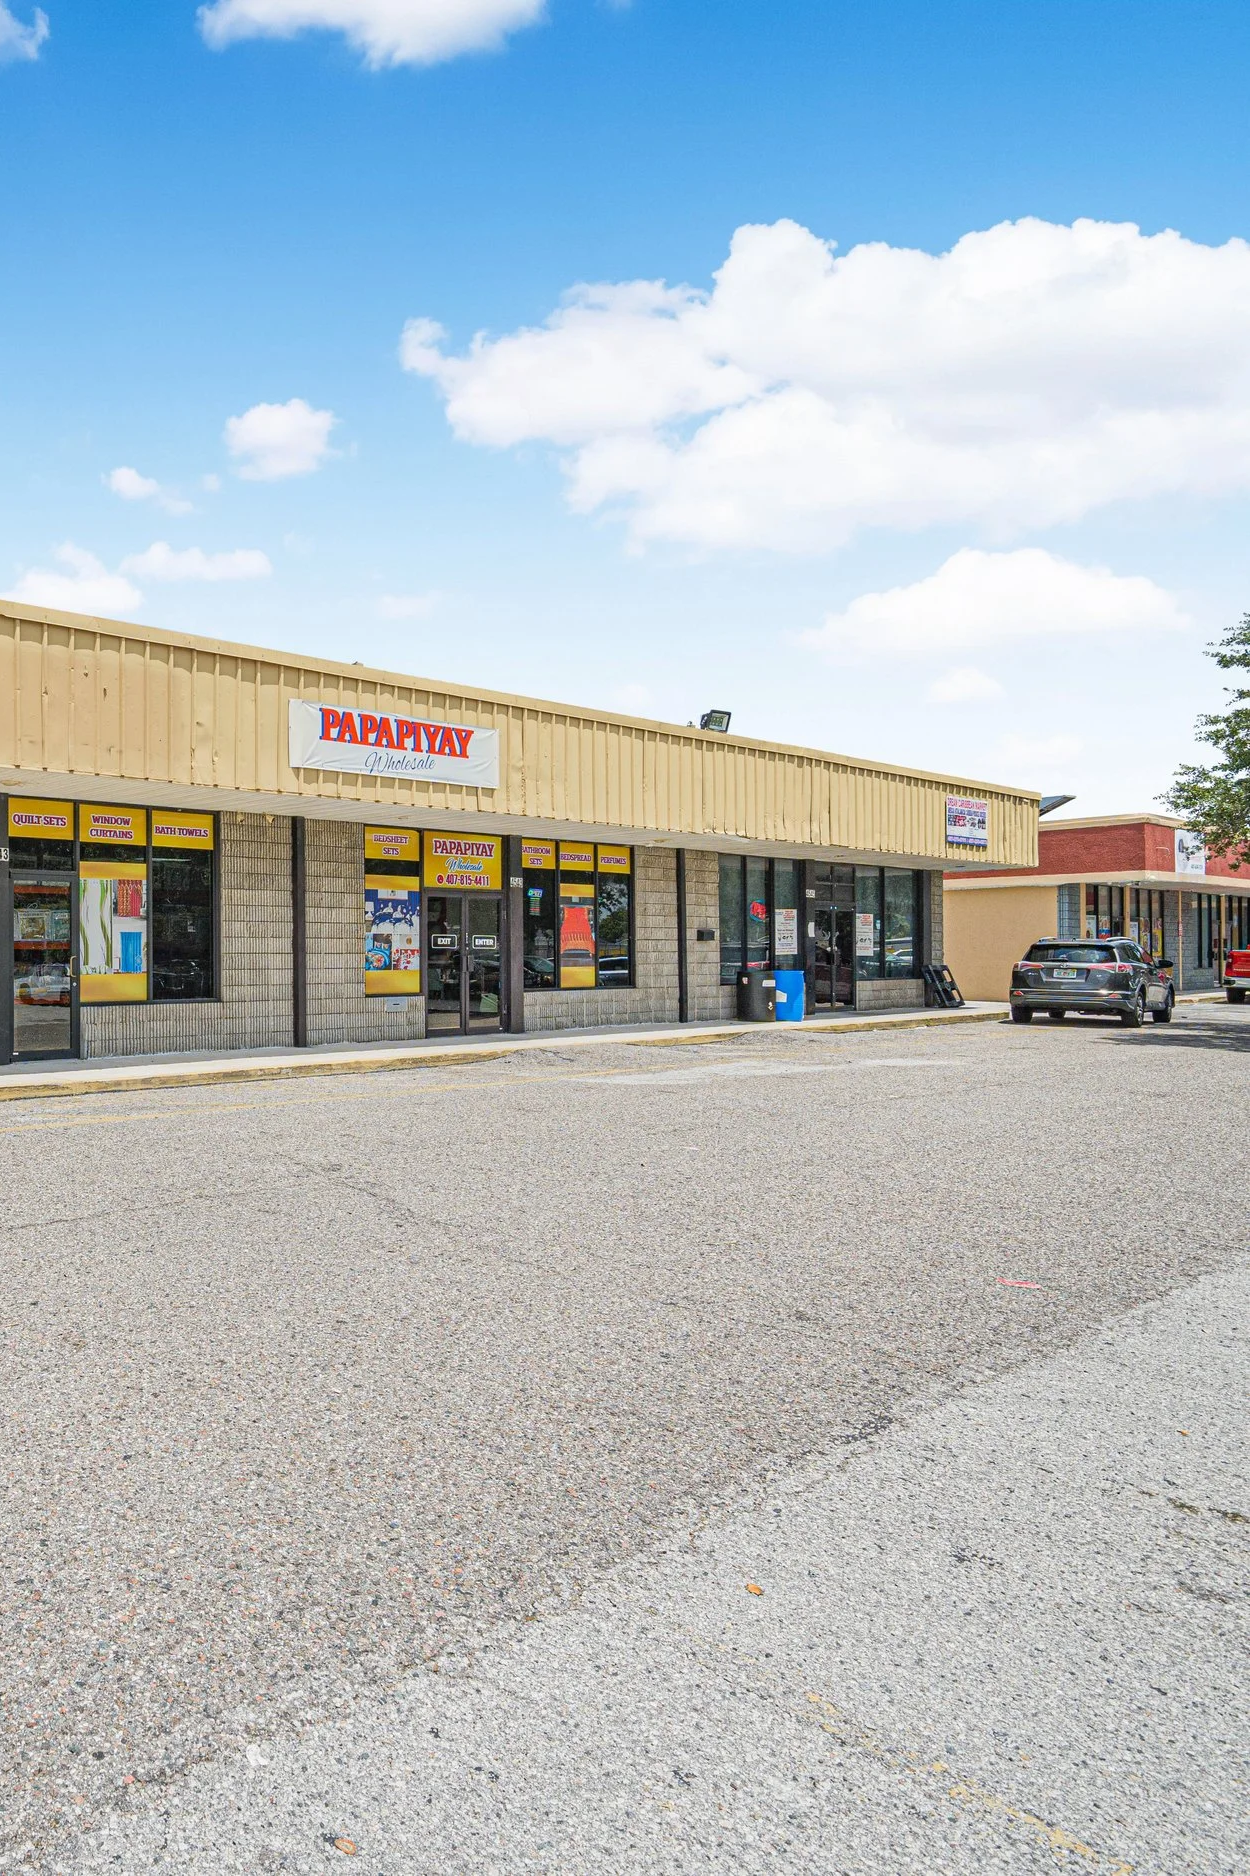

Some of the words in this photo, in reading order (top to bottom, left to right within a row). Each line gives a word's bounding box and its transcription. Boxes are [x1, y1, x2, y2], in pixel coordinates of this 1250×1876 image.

[319, 707, 475, 759] PAPAPIYAY
[364, 751, 436, 774] Wholesale
[12, 813, 42, 826] QUILT
[43, 814, 67, 827] SETS
[92, 815, 131, 826] WINDOW
[89, 828, 133, 840] CURTAINS
[154, 826, 177, 836] BATH
[177, 828, 209, 838] TOWELS
[373, 835, 409, 844] BEDSHEET
[382, 847, 400, 856] SETS
[433, 839, 495, 857] PAPAPIYAY
[529, 857, 543, 865] SETS
[560, 853, 592, 862] BEDSPREAD
[600, 856, 627, 865] PERFUMES
[445, 857, 483, 872] Wholesale
[445, 874, 489, 886] 407-815-4411
